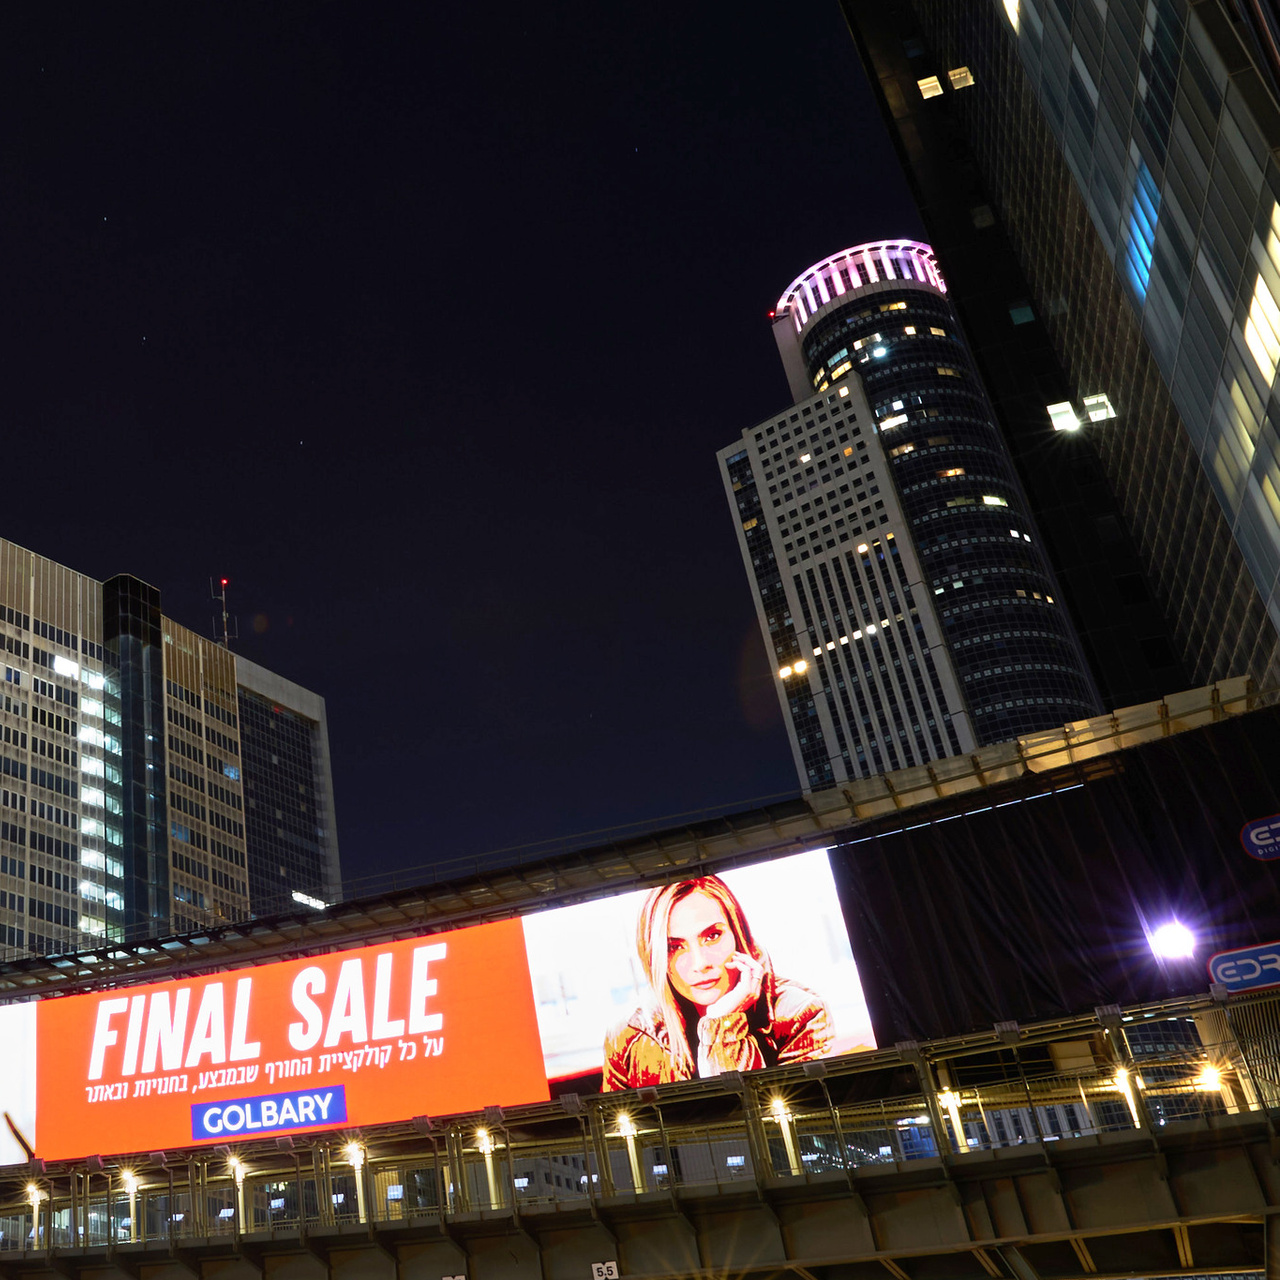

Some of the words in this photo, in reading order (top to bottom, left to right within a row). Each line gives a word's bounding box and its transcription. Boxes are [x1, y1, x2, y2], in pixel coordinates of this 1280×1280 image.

[88, 977, 261, 1081] FINAL
[288, 942, 448, 1052] SALE
[319, 1044, 392, 1073] קולקציית
[398, 1040, 417, 1061] כל
[423, 1036, 444, 1058] על
[192, 1064, 259, 1095] שבמבצע,
[265, 1056, 312, 1086] החורף
[85, 1082, 128, 1104] ובאתר
[134, 1073, 188, 1099] בחנויות
[202, 1092, 333, 1134] GOLBARY
[596, 1265, 614, 1277] 5.5
